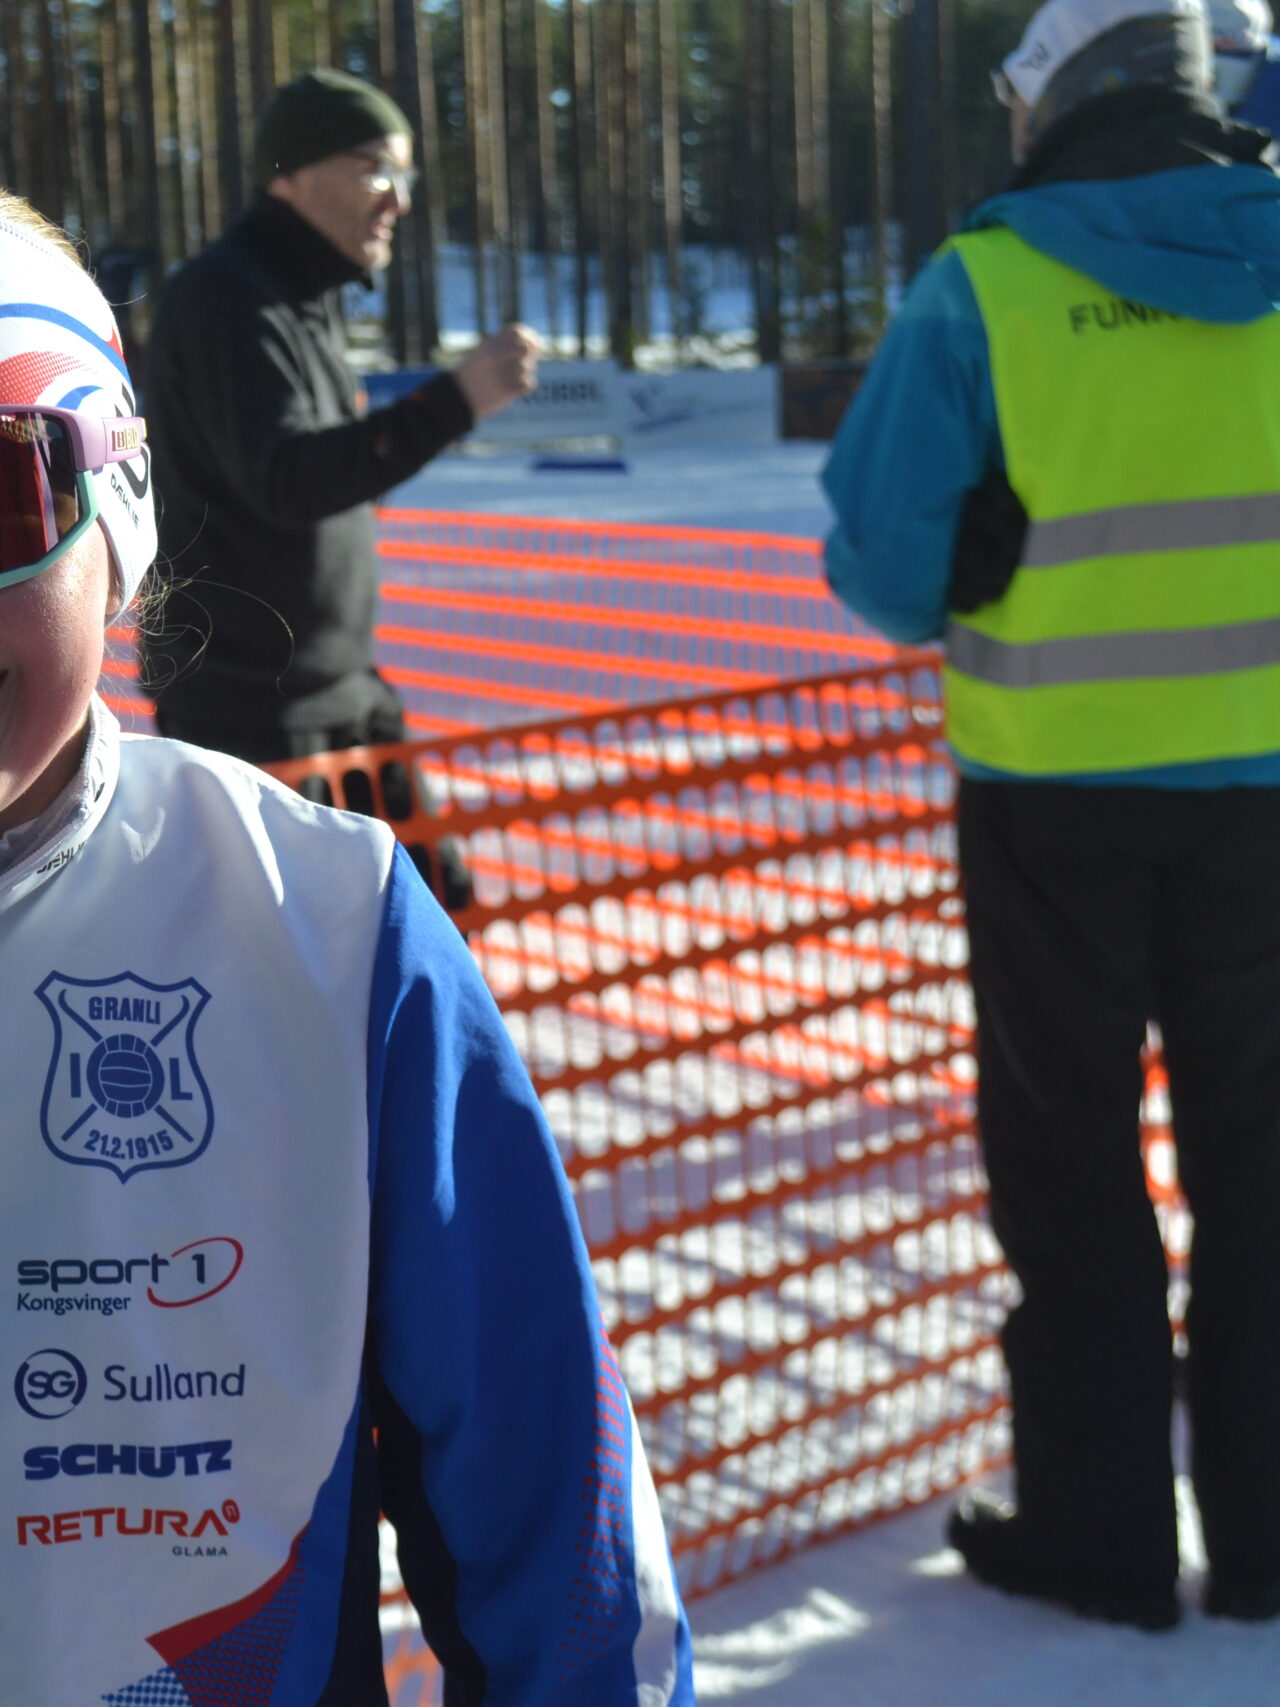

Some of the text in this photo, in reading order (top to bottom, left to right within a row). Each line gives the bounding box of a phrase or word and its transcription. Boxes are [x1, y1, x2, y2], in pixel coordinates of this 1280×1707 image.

[88, 996, 161, 1025] GRANLI
[69, 1053, 193, 1100] I L
[84, 1129, 175, 1160] 21.2.1915
[17, 1252, 206, 1294] sport 1
[16, 1292, 132, 1316] Kongsvinger
[27, 1370, 77, 1400] SG
[103, 1362, 246, 1402] Sulland
[16, 1507, 229, 1546] RETURA
[172, 1545, 228, 1558] GLAMA
